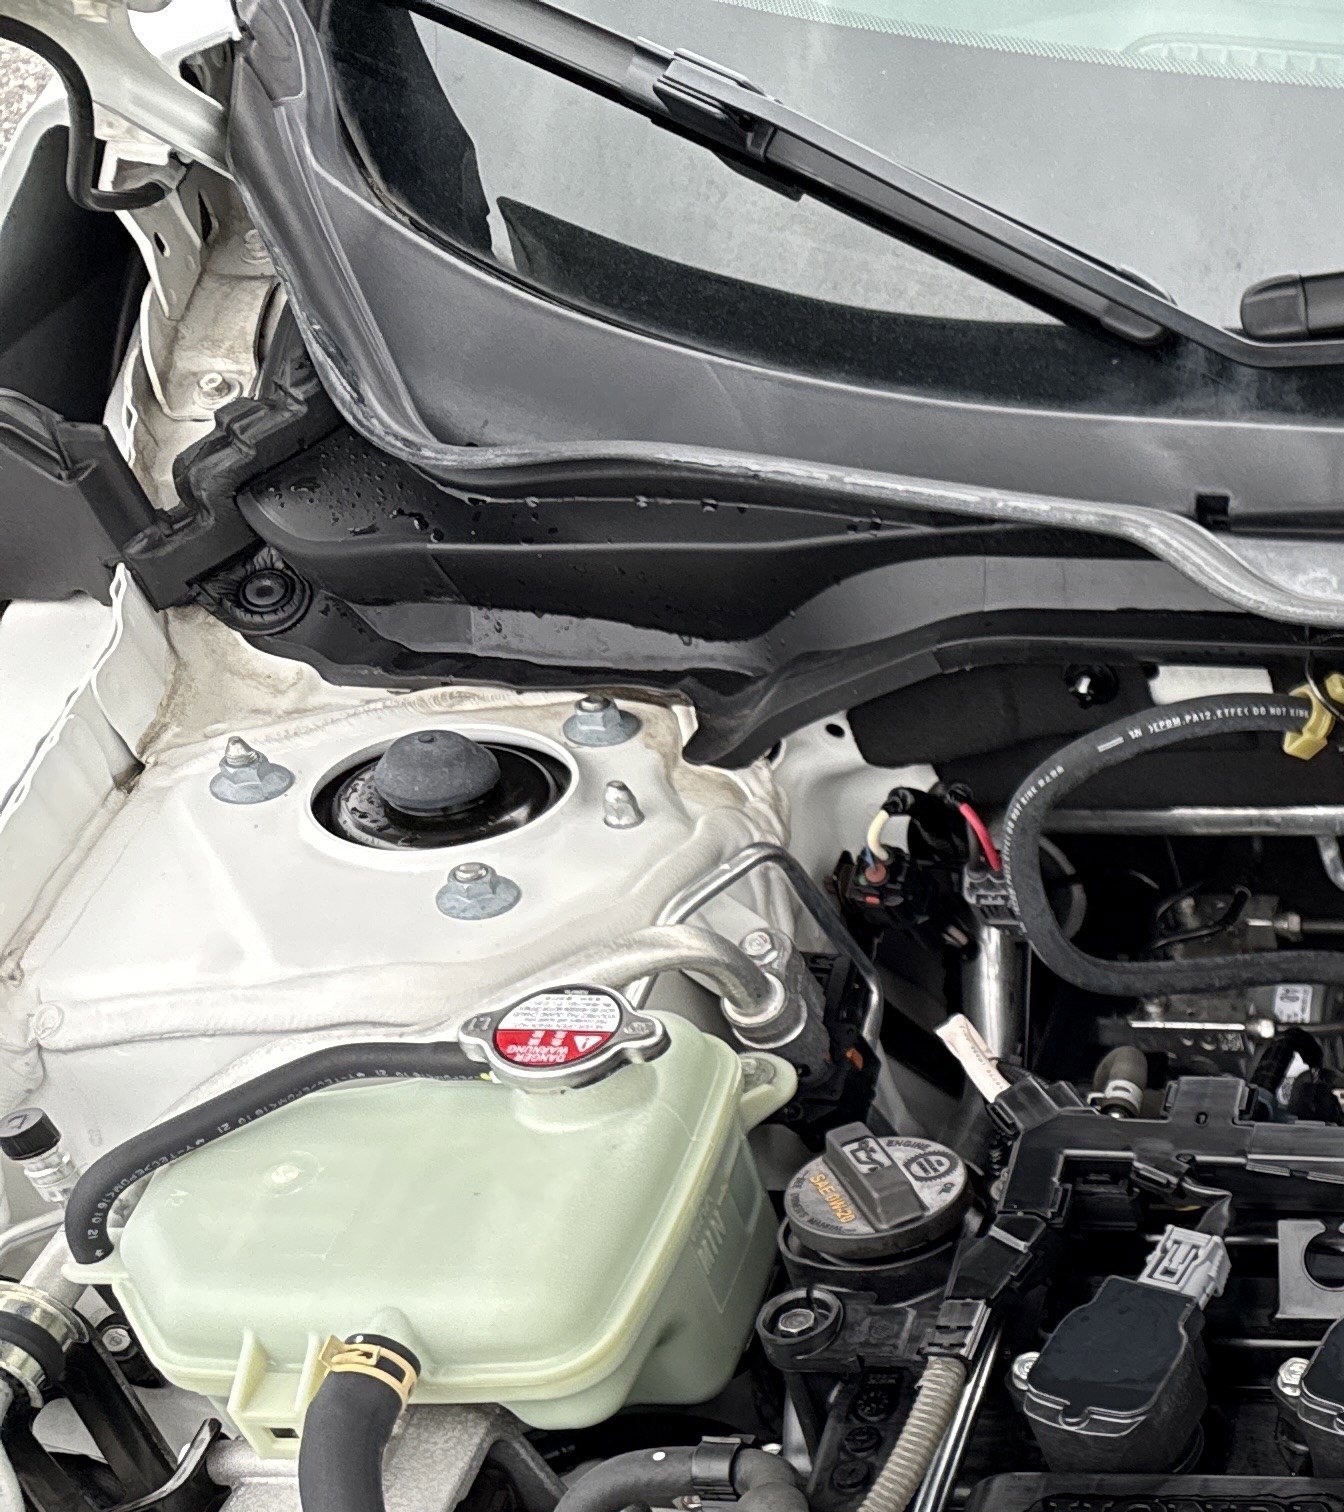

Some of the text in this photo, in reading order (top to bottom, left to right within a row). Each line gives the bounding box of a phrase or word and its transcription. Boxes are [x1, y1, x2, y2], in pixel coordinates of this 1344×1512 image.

[1270, 706, 1287, 717] NOT
[514, 1053, 567, 1062] DANGER
[886, 1139, 931, 1151] ENGINE
[810, 1173, 856, 1224] SAE 0W-20
